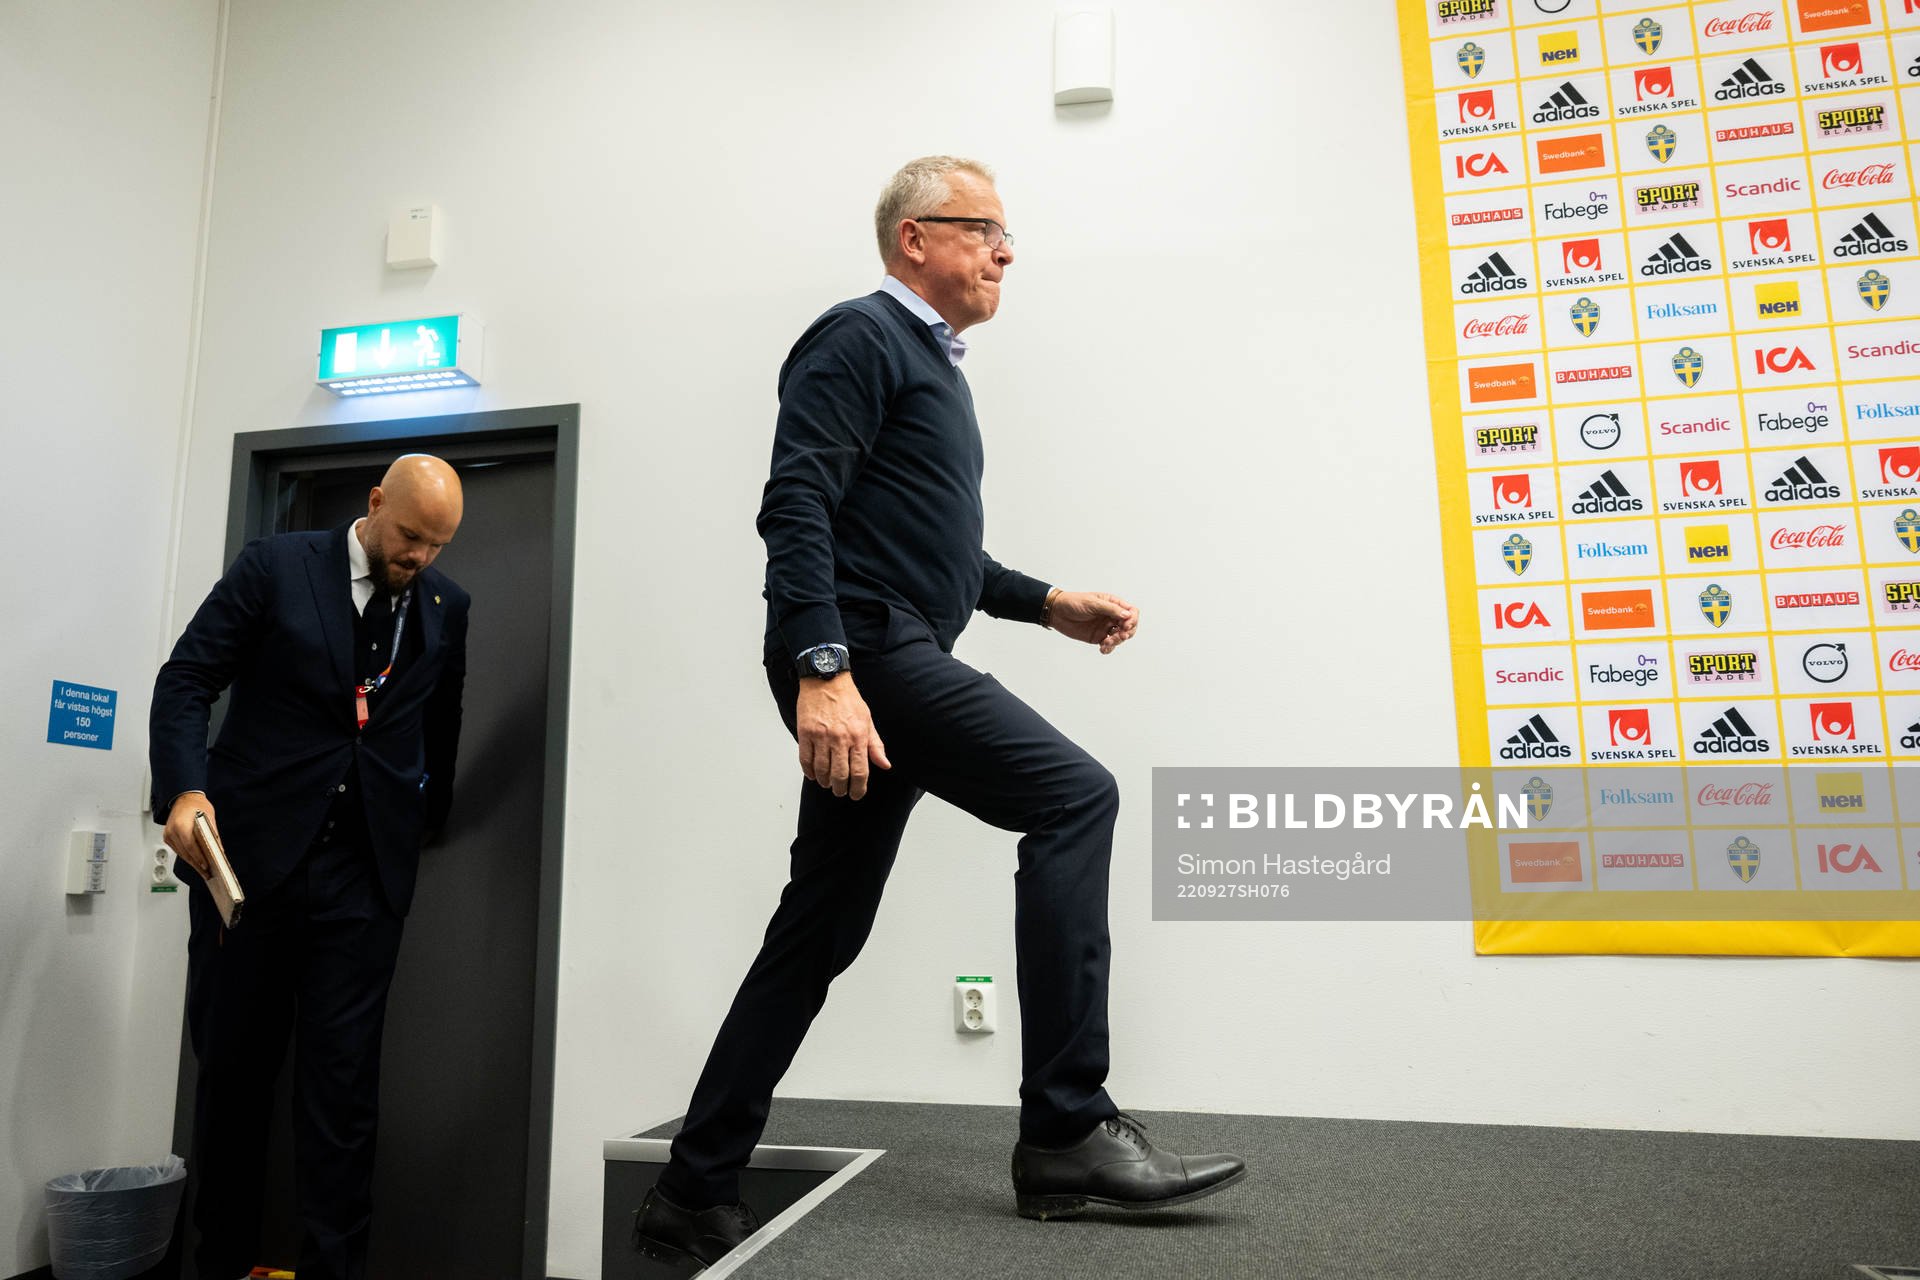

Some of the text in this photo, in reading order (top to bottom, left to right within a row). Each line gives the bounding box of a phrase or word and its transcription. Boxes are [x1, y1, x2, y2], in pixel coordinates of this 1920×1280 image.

[1438, 0, 1495, 18] SPORT
[1803, 7, 1849, 19] Swedbank
[1442, 12, 1494, 24] BLADET
[1704, 11, 1774, 37] Coca-Cola
[1714, 81, 1785, 101] adidas
[1805, 76, 1888, 93] SVENSKA SPEL
[1533, 105, 1600, 123] adidas
[1619, 99, 1697, 115] SVENSKA SPEL
[1819, 105, 1885, 129] SPORT
[1442, 121, 1517, 137] SVENSKA SPEL
[1716, 122, 1794, 142] BAUHAUS
[1824, 123, 1884, 136] BLADET
[1542, 149, 1585, 161] Swedbank
[1456, 152, 1510, 179] ICA
[1822, 163, 1896, 190] Coca-Cola
[1637, 183, 1699, 206] SPORT
[1726, 178, 1801, 198] Scandic
[1545, 202, 1609, 220] Fabege
[1642, 201, 1698, 212] BLADET
[1452, 208, 1522, 225] BAUHAUS
[1833, 239, 1908, 257] adidas
[1641, 257, 1712, 276] adidas
[1733, 254, 1816, 269] SVENSKA SPEL
[1461, 276, 1527, 294] adidas
[1546, 273, 1624, 288] SVENSKA SPEL
[1647, 303, 1717, 319] Folksam
[1463, 314, 1530, 339] Coca-Cola
[1848, 340, 1920, 359] Scandic
[1755, 346, 1816, 375] ICA
[1556, 366, 1632, 383] BAUHAUS
[1474, 378, 1517, 389] Swedbank
[1660, 418, 1730, 435] Scandic
[1758, 412, 1829, 432] Fabege
[1477, 425, 1538, 447] SPORT
[1481, 444, 1537, 454] BLADET
[1764, 484, 1841, 502] adidas
[1863, 487, 1917, 498] SVENSKA
[1572, 496, 1643, 514] adidas
[1663, 498, 1747, 511] SVENSKA SPEL
[1476, 511, 1554, 523] SVENSKA SPEL
[1770, 524, 1847, 550] Coca-Cola
[1577, 543, 1648, 559] Folksam
[1775, 592, 1860, 608] BAUHAUS
[1494, 601, 1551, 629] ICA
[1587, 606, 1634, 616] Swedbank
[1689, 652, 1756, 675] SPORT
[1496, 668, 1564, 684] Scandic
[1590, 664, 1658, 686] Fabege
[1694, 673, 1755, 682] BLADET
[65, 687, 90, 700] denna
[91, 692, 110, 703] lokal
[54, 698, 113, 718] får vistas högst
[75, 716, 91, 728] 150
[63, 730, 99, 742] personer
[1500, 742, 1571, 760] adidas
[1693, 736, 1770, 754] adidas
[1792, 744, 1882, 755] SVENSKA SPEL
[1592, 749, 1676, 760] SVENSKA SPEL
[1600, 788, 1674, 805] Folksam
[1698, 782, 1776, 806] Coca-Cola
[1515, 858, 1561, 868] Swedbank
[1603, 854, 1684, 868] BAUHAUS
[1817, 843, 1883, 874] ICA
